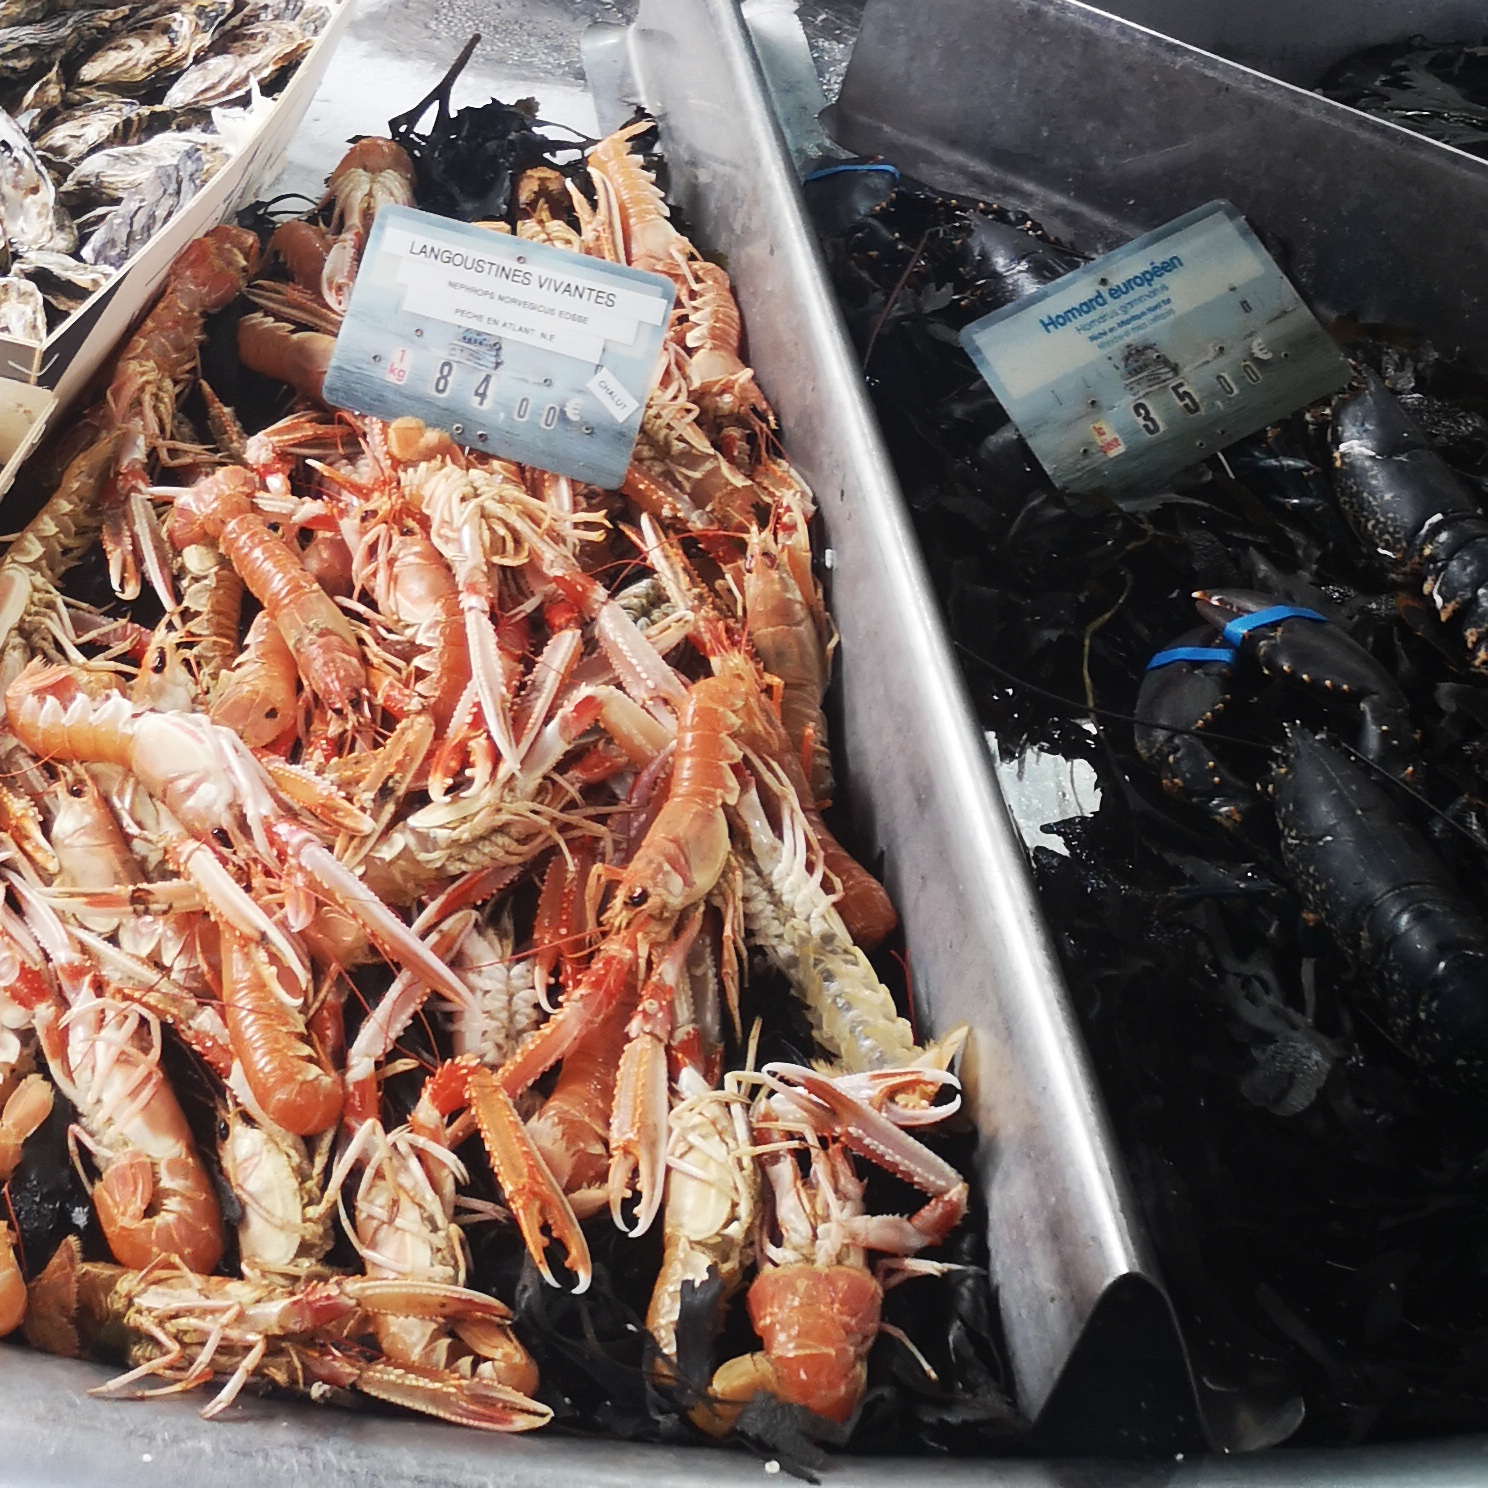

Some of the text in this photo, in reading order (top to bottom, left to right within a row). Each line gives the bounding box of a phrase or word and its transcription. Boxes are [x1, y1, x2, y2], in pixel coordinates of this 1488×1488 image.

[410, 240, 617, 308] LANGOUSTINES VIVANTES
[448, 280, 495, 300] NEPHROPS
[497, 294, 555, 316] NORVEGICUS
[1039, 289, 1108, 334] Homard
[1108, 255, 1184, 301] européen
[455, 308, 483, 323] PECHE
[487, 317, 499, 326] EN
[597, 379, 628, 412] CHALUT
